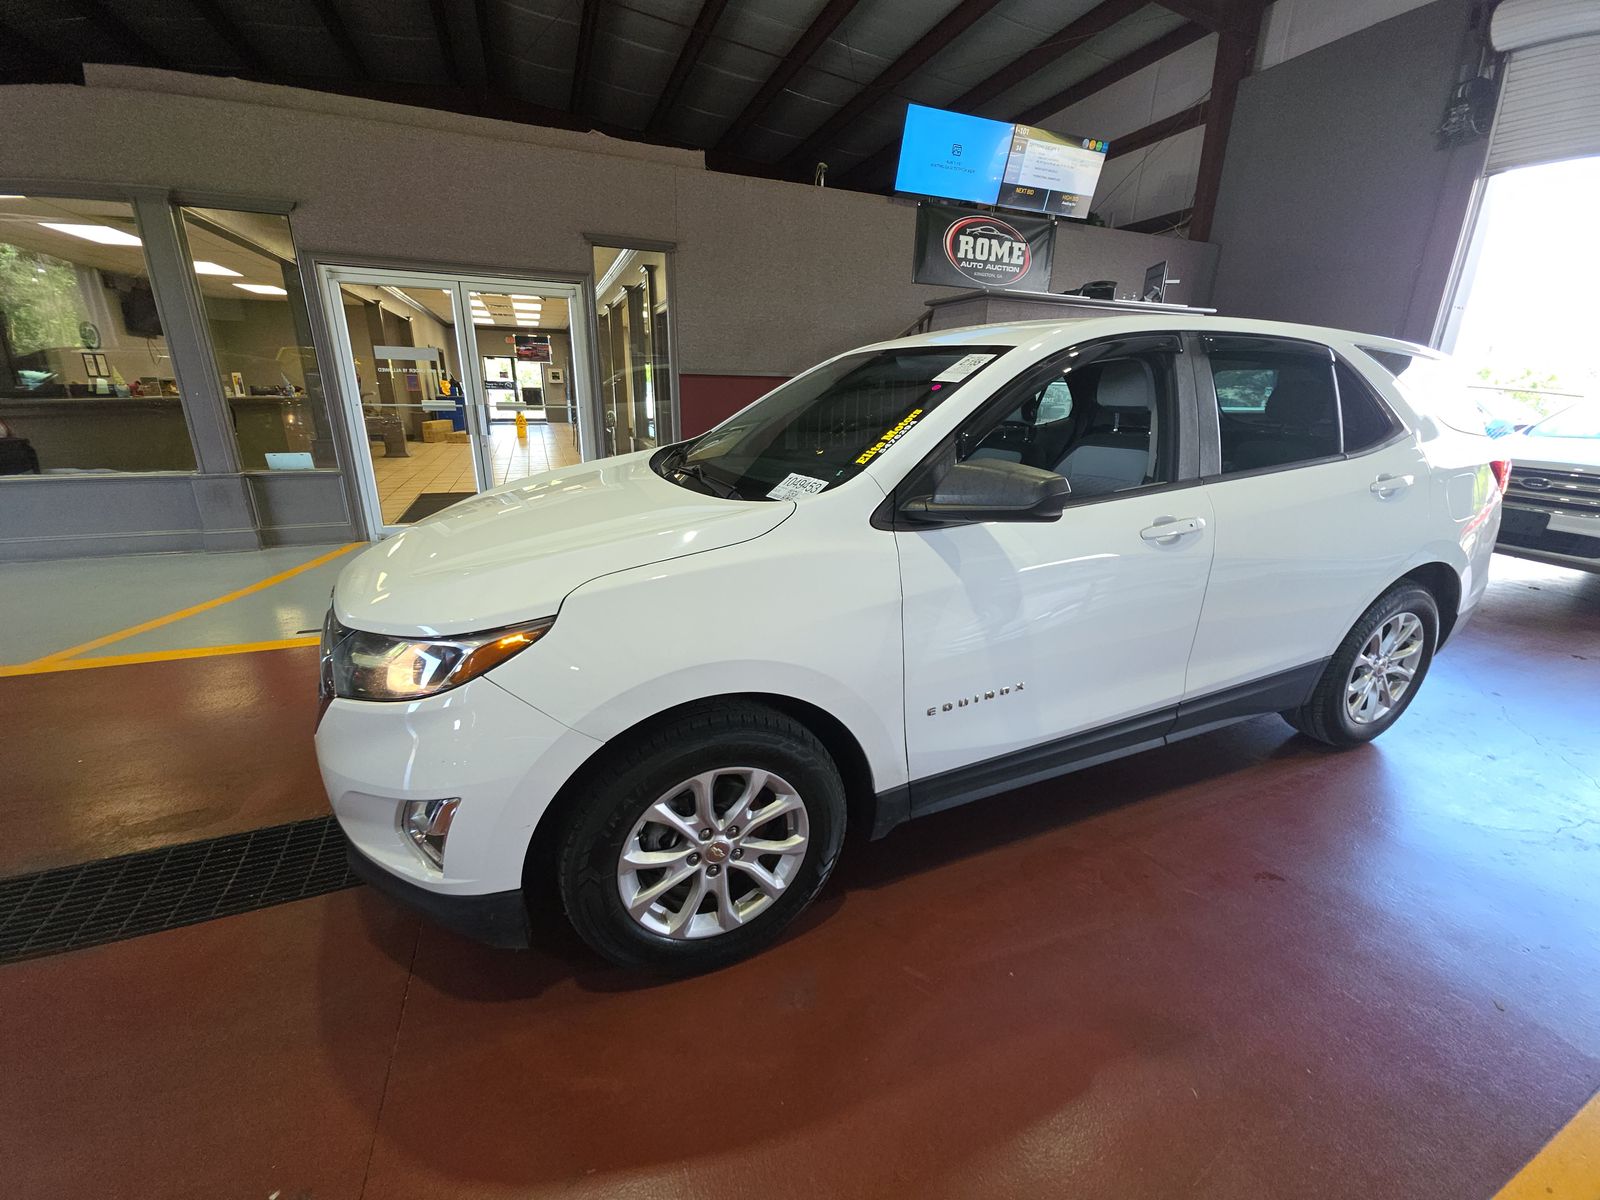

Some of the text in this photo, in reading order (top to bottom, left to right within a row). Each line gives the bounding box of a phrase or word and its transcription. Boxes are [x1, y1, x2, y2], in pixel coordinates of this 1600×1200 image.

[957, 236, 1027, 265] ROME
[960, 261, 1020, 273] AUTO AUCTION
[855, 408, 923, 465] Elite Motors
[783, 476, 822, 493] 1049453
[926, 681, 1025, 716] EQUINOX
